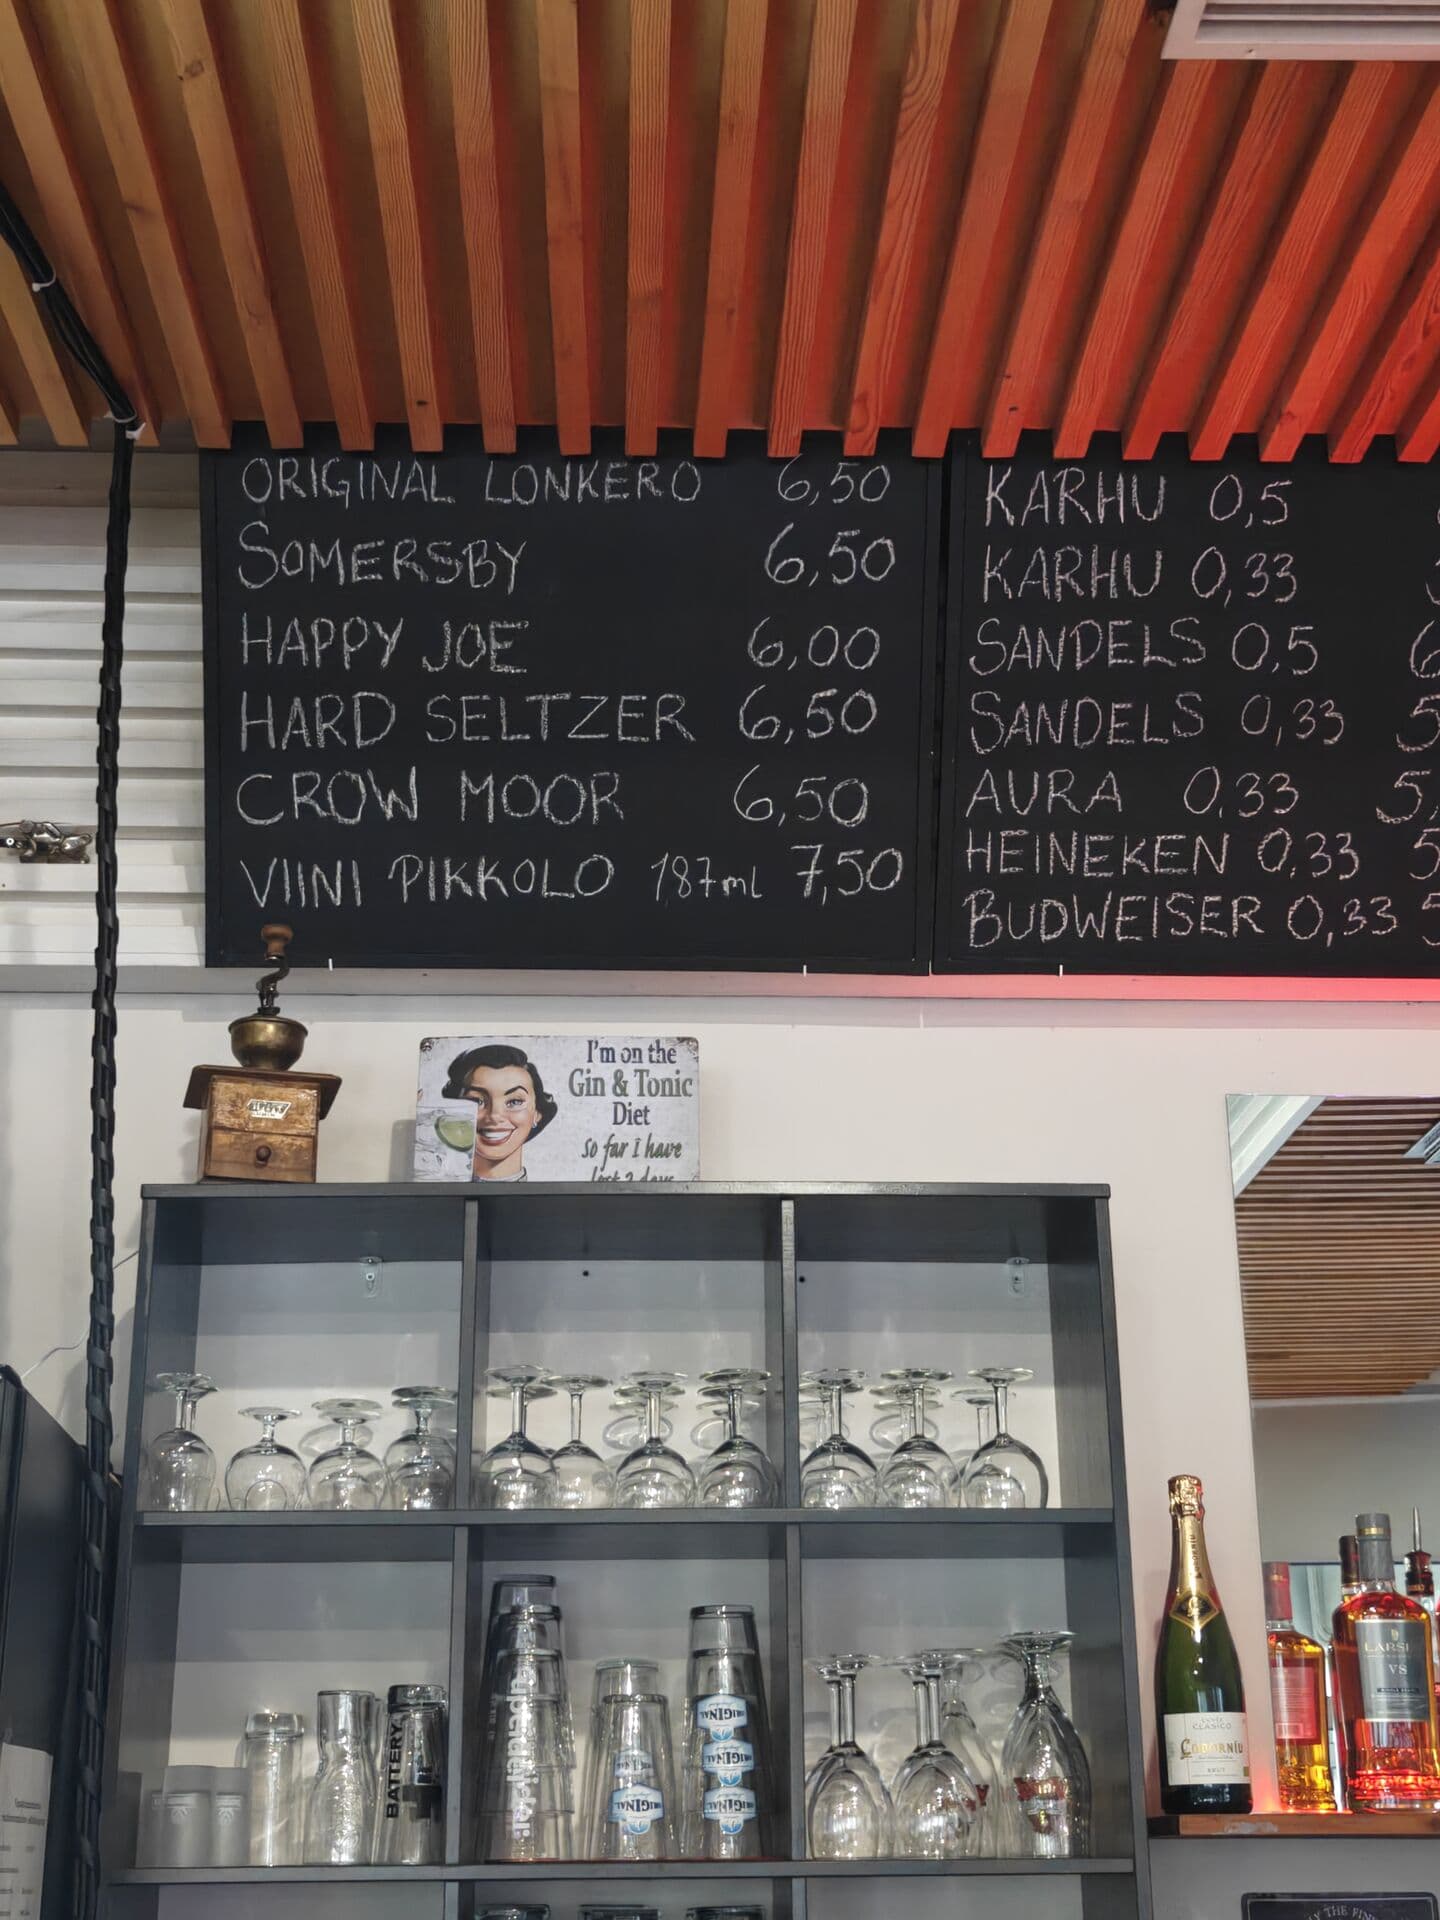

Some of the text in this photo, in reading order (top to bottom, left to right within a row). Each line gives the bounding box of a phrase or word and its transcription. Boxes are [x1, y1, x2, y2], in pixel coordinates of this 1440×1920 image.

[242, 457, 701, 509] ORIGINAL LONKERO
[777, 454, 891, 506] 6,50
[985, 464, 1293, 529] KARHU 0,5
[238, 520, 527, 595] SOMERSBY
[764, 522, 896, 587] 6,50
[983, 544, 1297, 607] KARHU 0,33
[241, 612, 529, 674] HAPPY JOE
[747, 616, 881, 671] 6,00
[968, 616, 1318, 676] SANDELS 0,5
[241, 691, 695, 752] HARD SELTZER
[738, 684, 878, 745] 6,50
[970, 690, 1344, 755] SANDELS 0,33
[236, 765, 624, 826] CROW MOOR
[733, 764, 869, 828] 6,50
[965, 765, 1299, 819] AURA 0,33
[239, 857, 362, 908] VIINI
[387, 853, 615, 904] PIKKOLO
[790, 843, 903, 905] 7,50
[965, 827, 1360, 881] HEINEKEN 0,33
[962, 887, 1398, 948] BUDWEISER 0,33
[587, 1039, 677, 1063] I'm on the
[568, 1068, 693, 1097] Gin & Tonic
[612, 1101, 650, 1125] Diet
[602, 1133, 629, 1172] far
[644, 1133, 682, 1158] have
[1388, 1664, 1408, 1675] VS
[386, 1722, 403, 1819] BATTERY
